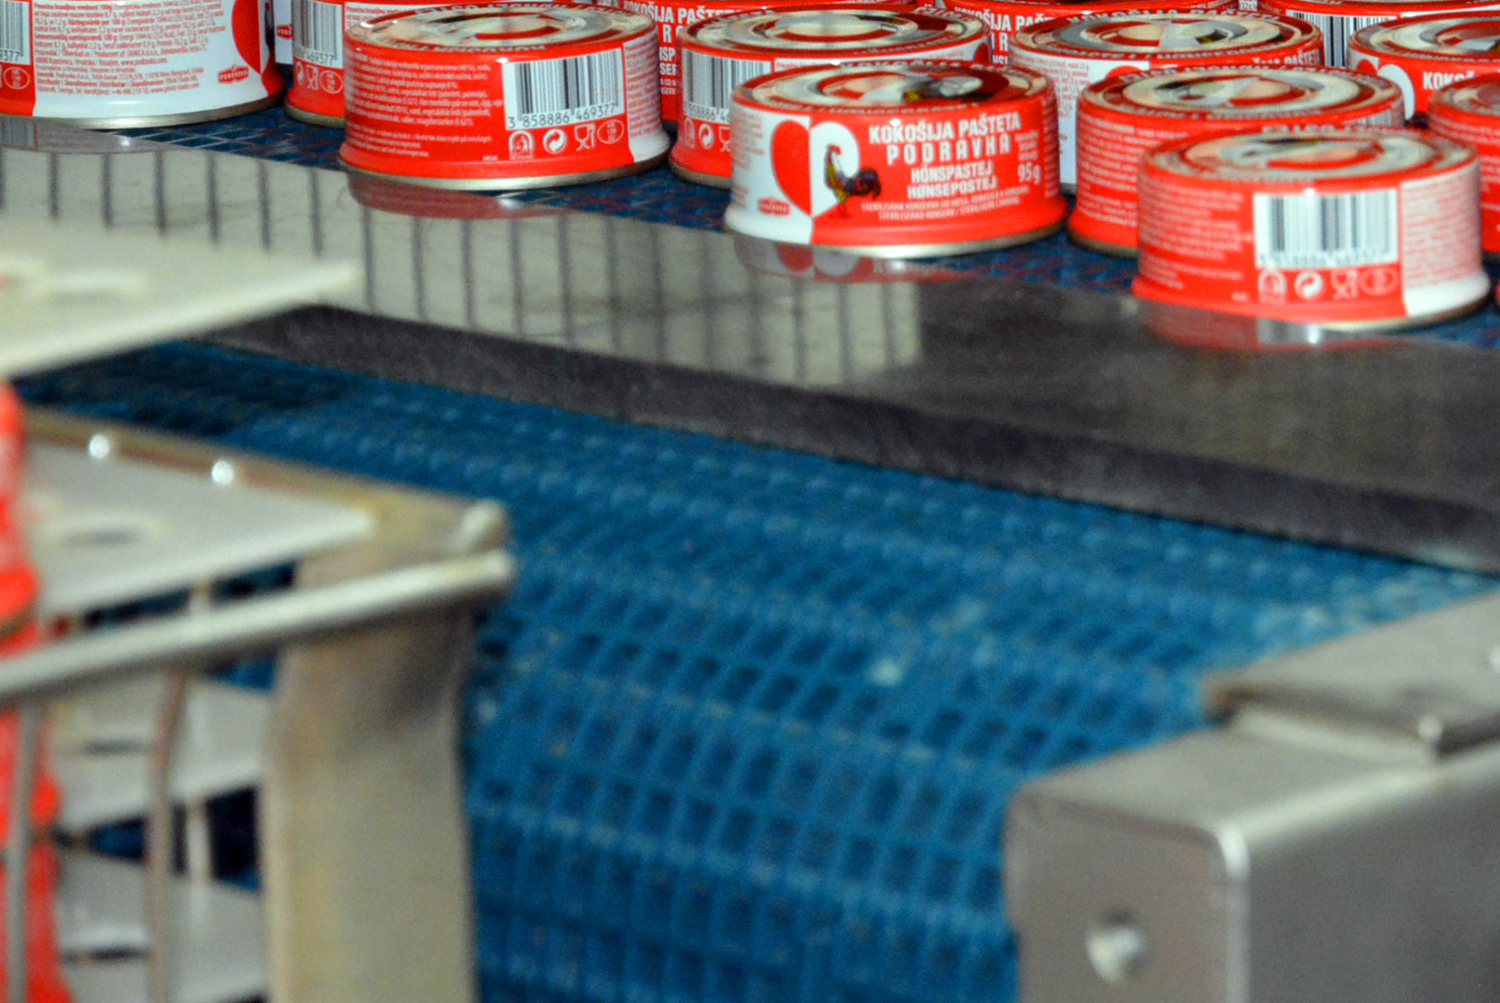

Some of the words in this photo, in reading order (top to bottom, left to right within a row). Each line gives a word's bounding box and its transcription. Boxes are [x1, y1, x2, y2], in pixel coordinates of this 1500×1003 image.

[508, 115, 516, 130] 3
[522, 111, 571, 129] 858886
[575, 102, 617, 121] 469377
[869, 119, 955, 145] KOKOŠIJA
[958, 111, 1023, 138] PAŠTETA
[1017, 162, 1042, 185] 95g
